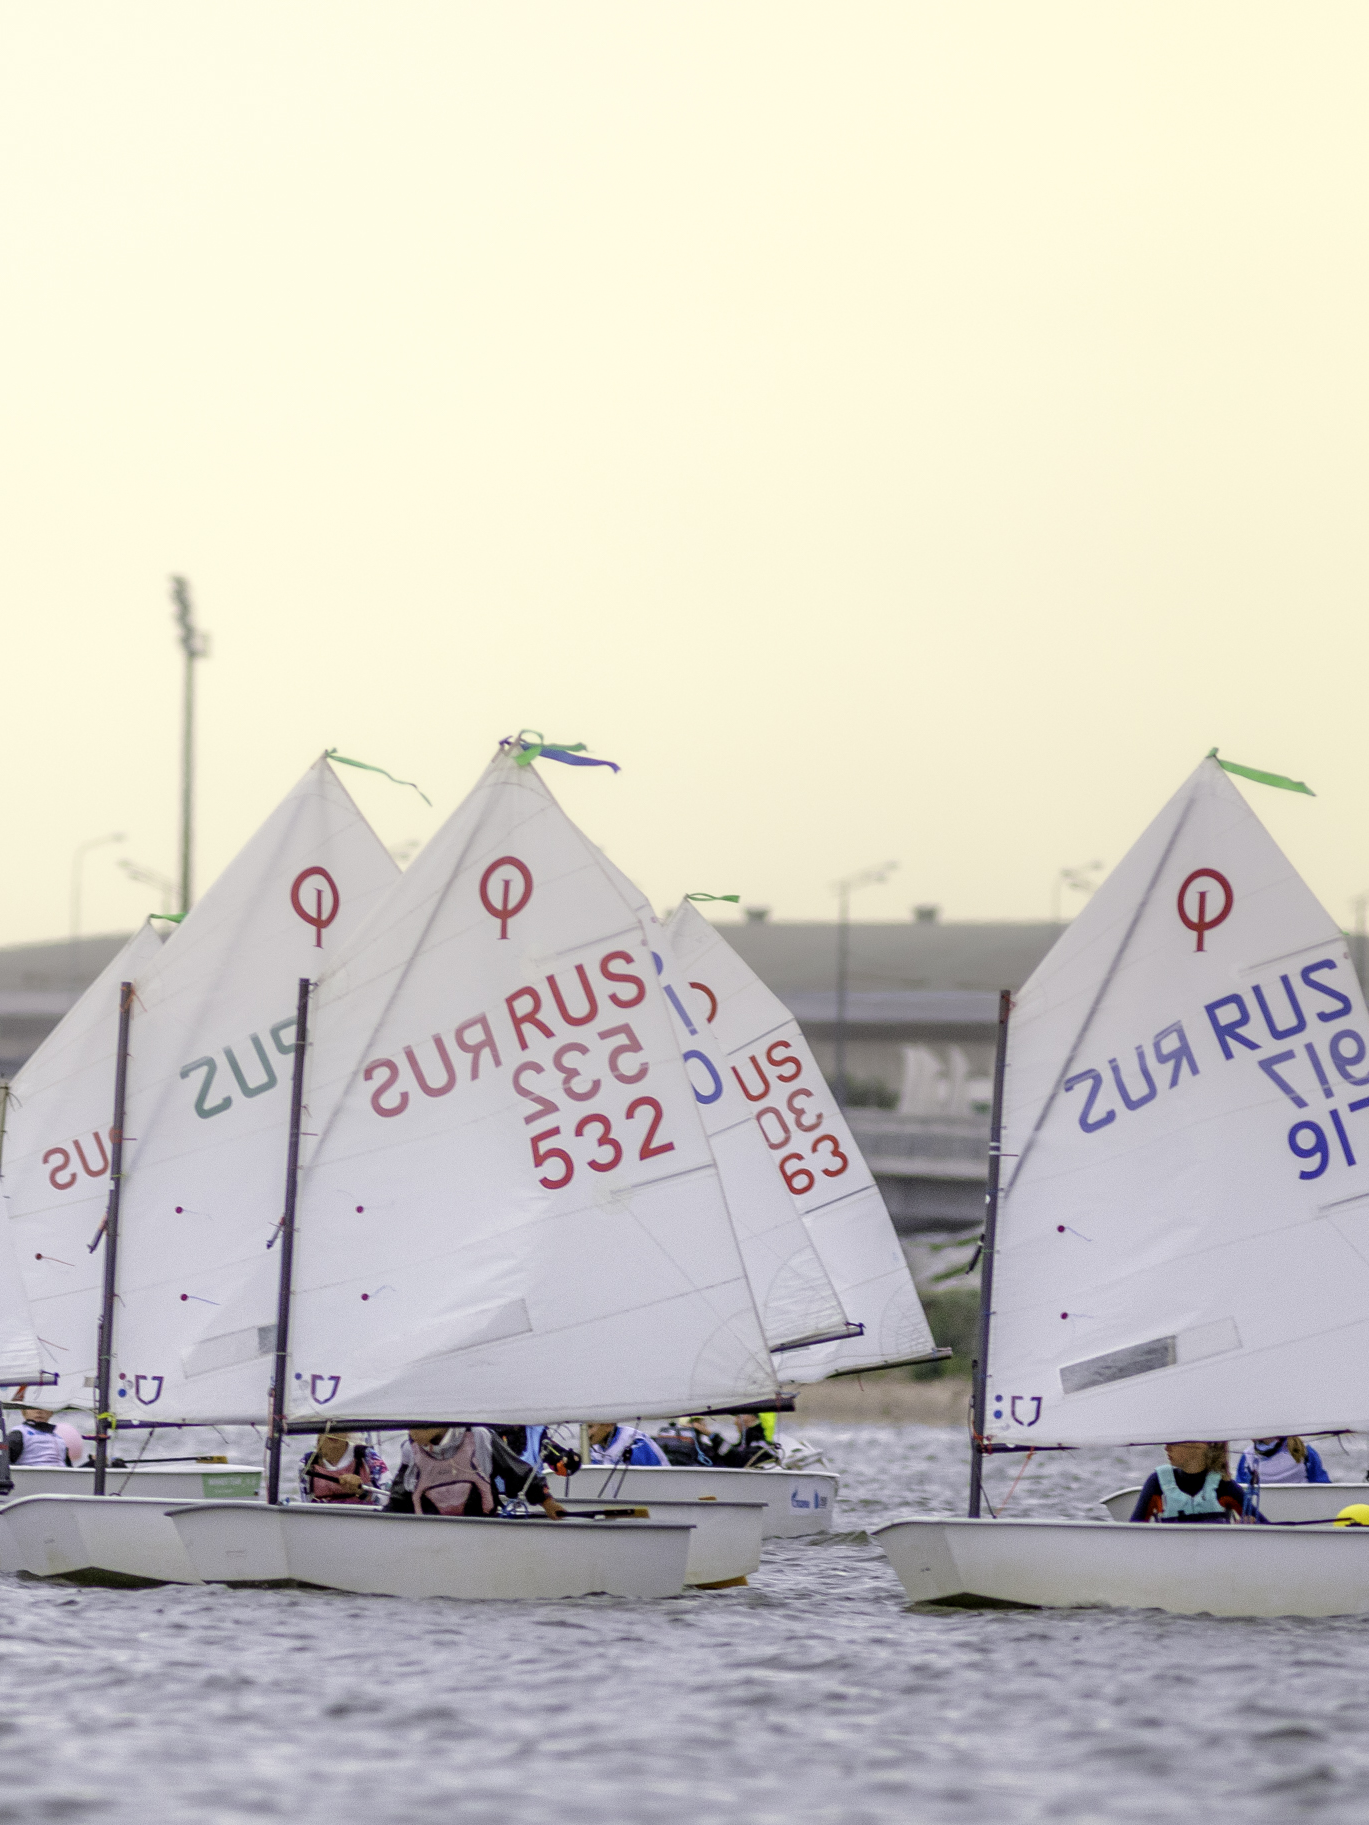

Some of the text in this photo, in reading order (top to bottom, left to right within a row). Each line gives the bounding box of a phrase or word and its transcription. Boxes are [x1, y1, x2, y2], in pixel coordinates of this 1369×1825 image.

[505, 950, 647, 1051] RUS
[1204, 958, 1353, 1060] RUS
[730, 1040, 803, 1102] US
[530, 1096, 675, 1189] 532
[778, 1134, 849, 1195] 63
